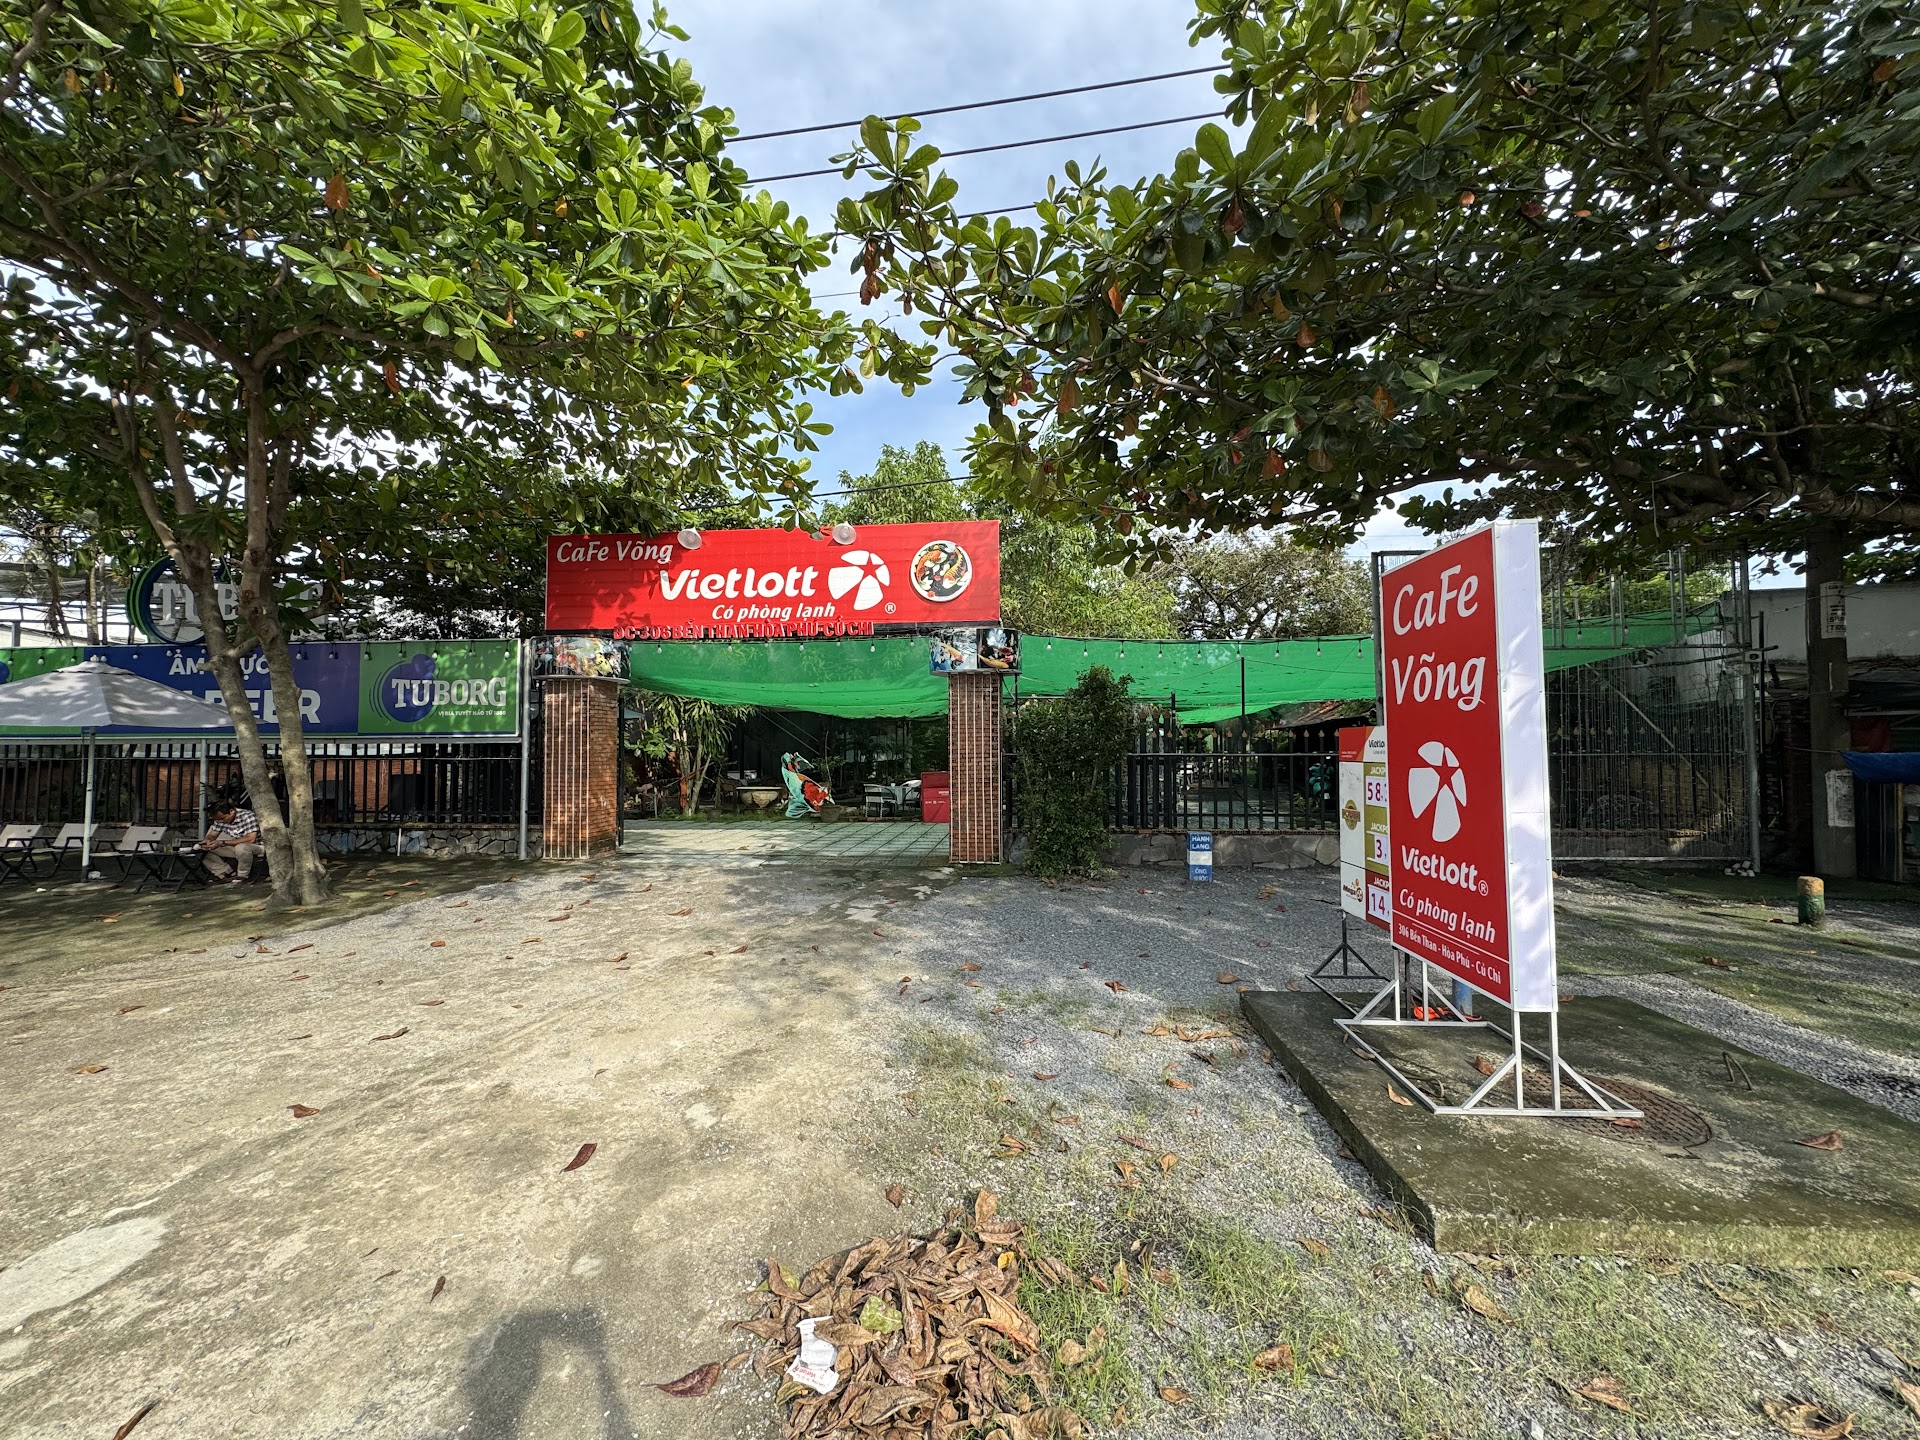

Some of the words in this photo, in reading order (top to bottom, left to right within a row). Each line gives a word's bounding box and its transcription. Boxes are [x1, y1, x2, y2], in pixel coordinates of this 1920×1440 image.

[556, 541, 610, 563] CaFe
[616, 540, 674, 565] Võng
[660, 566, 818, 600] Vietlott
[1392, 564, 1479, 636] CaFe
[711, 604, 734, 620] Có
[736, 603, 793, 623] phòng
[795, 602, 836, 622] lạnh
[391, 676, 507, 708] TUBORG
[1391, 652, 1487, 712] Võng
[1402, 845, 1478, 892] Vietlott
[1399, 888, 1415, 909] Có
[1415, 897, 1458, 932] phòng
[1460, 911, 1496, 944] lạnh
[1487, 966, 1502, 984] Chi
